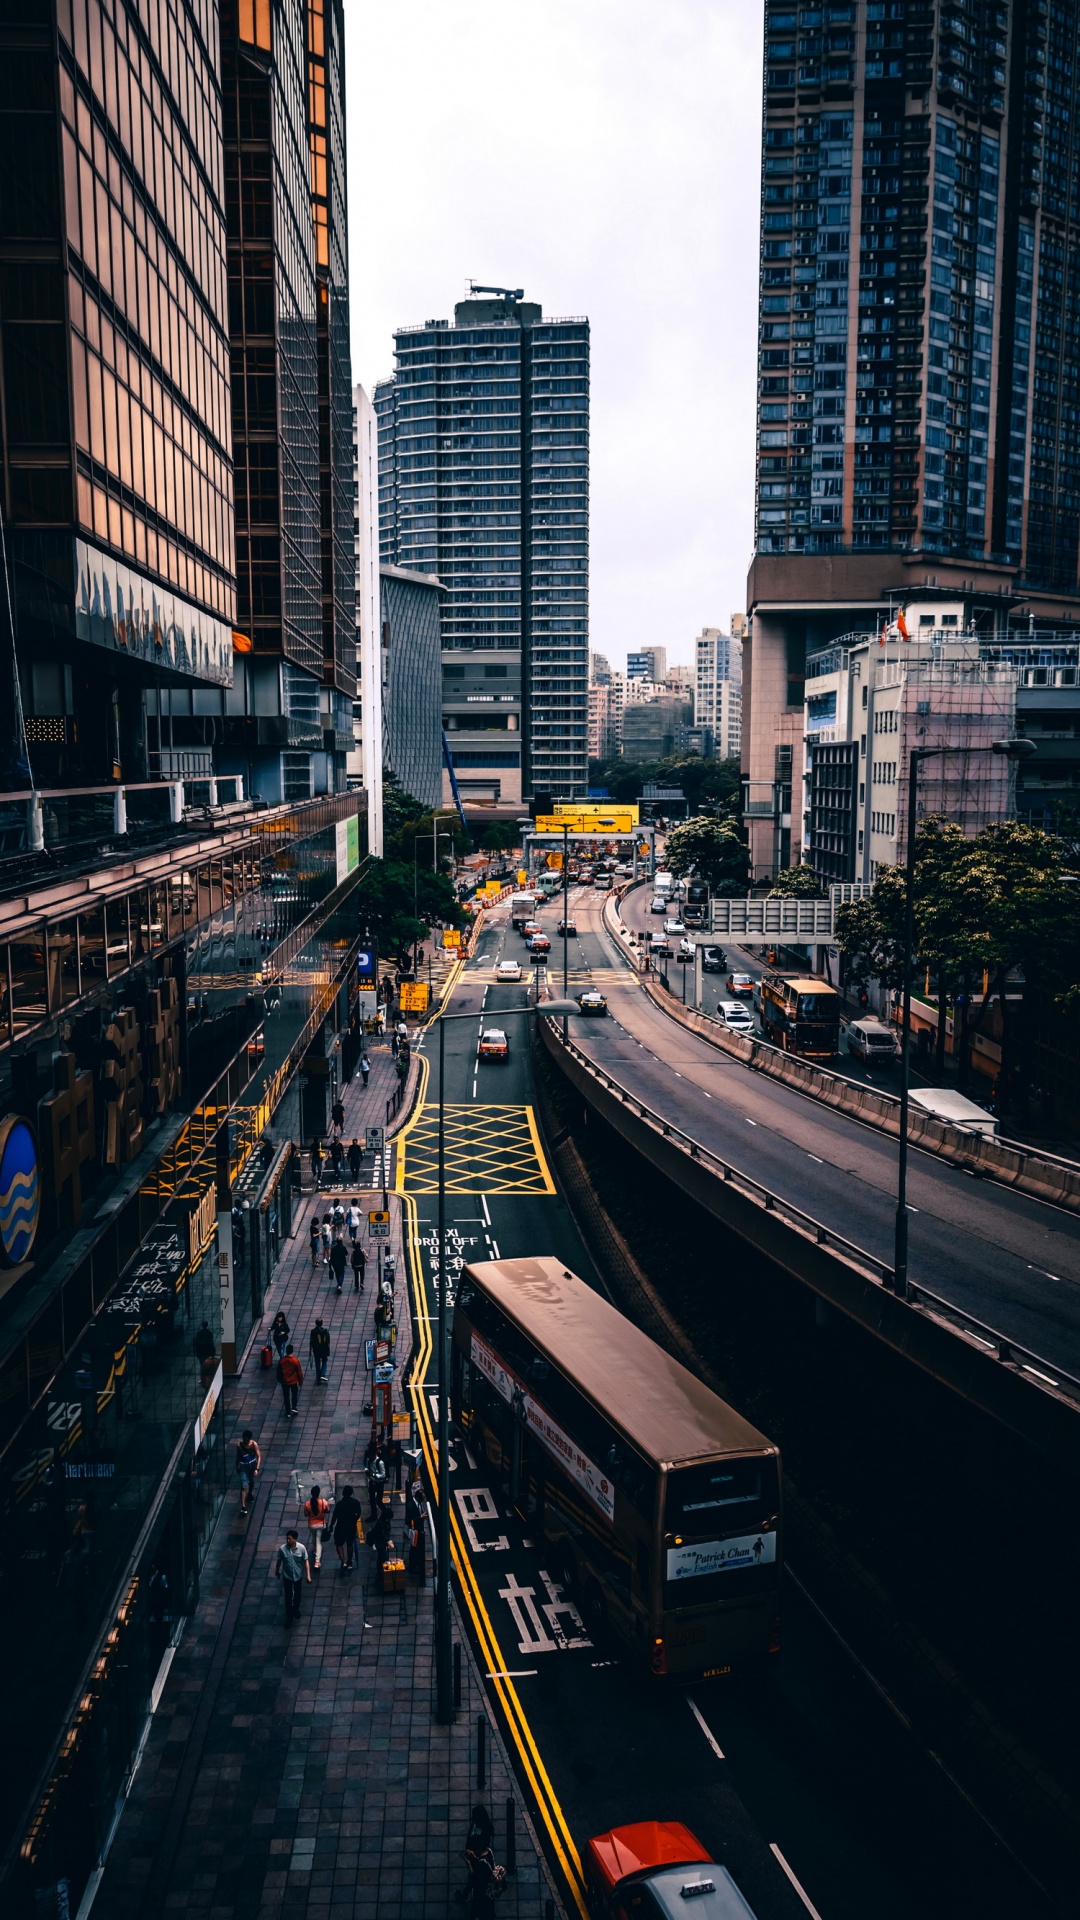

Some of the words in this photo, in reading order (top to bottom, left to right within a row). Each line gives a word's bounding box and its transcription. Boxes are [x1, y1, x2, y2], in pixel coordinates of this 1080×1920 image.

[429, 1229, 459, 1238] TXI
[452, 1237, 478, 1246] OFF
[694, 1550, 726, 1564] Patrick
[727, 1547, 750, 1559] Chan
[693, 1562, 718, 1573] English
[498, 1570, 596, 1655] 站
[686, 1883, 713, 1894] TAXI
